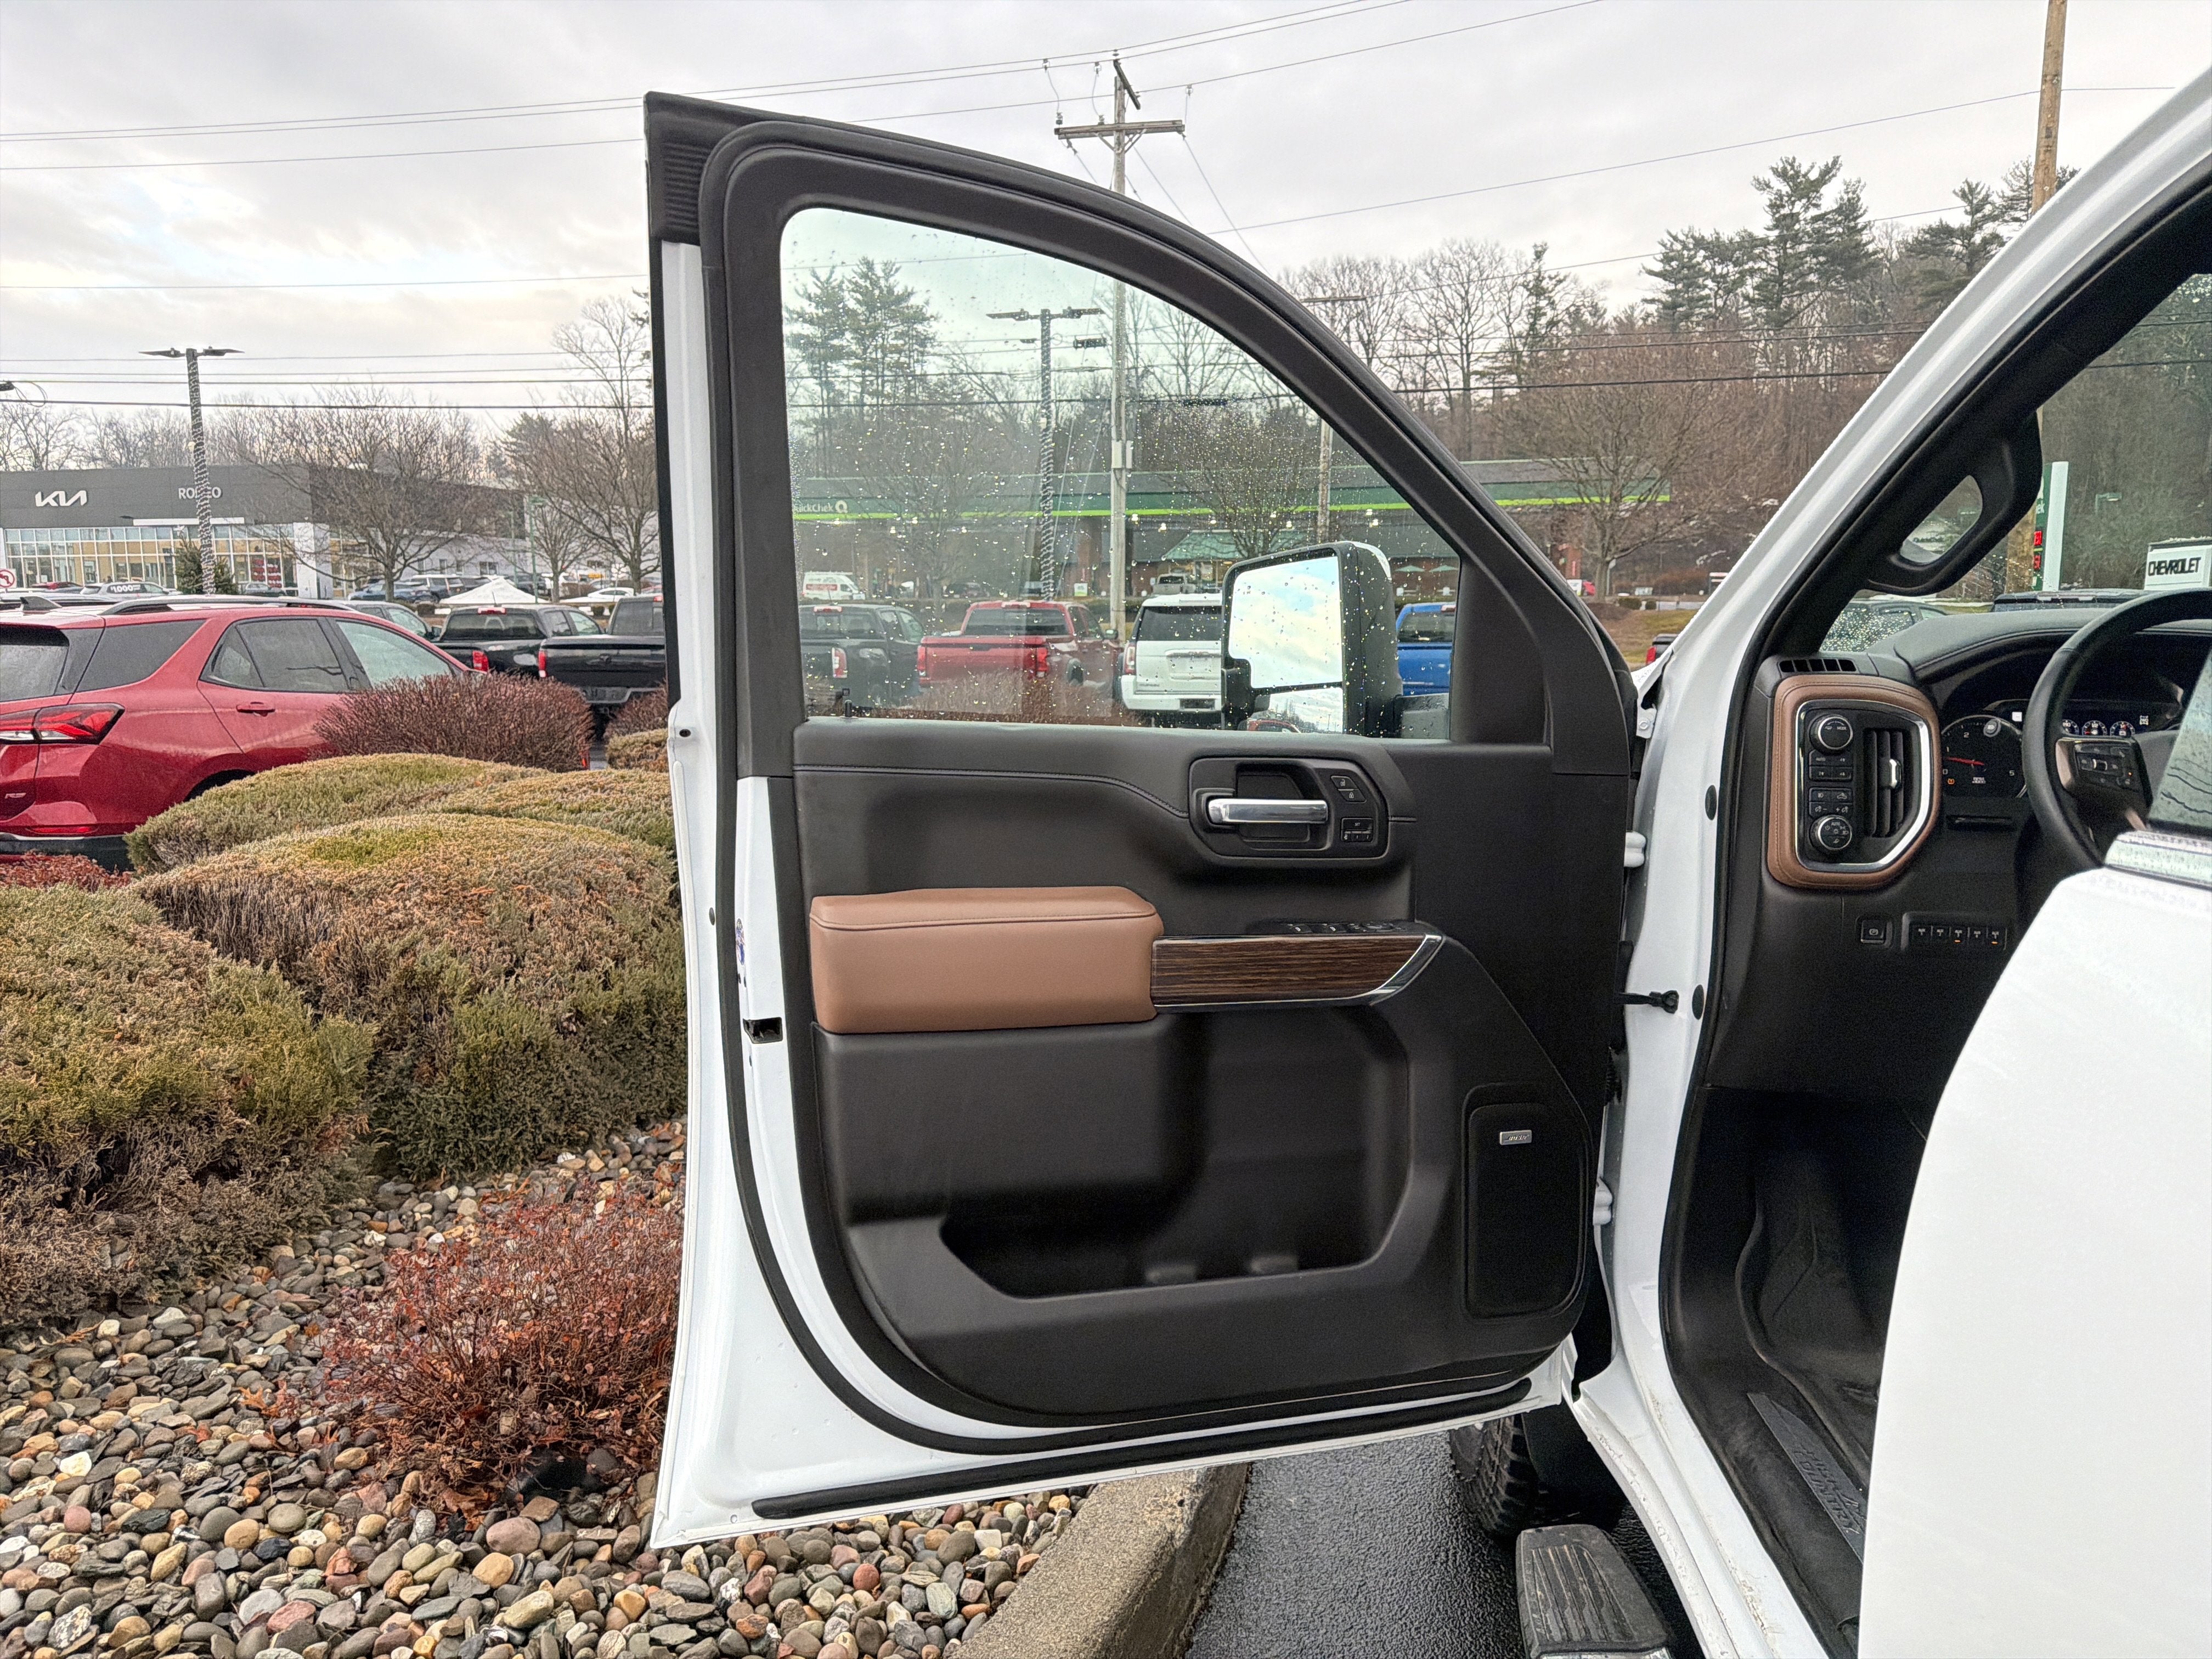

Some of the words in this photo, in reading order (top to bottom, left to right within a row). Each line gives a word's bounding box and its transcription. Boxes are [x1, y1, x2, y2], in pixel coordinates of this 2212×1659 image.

[35, 490, 88, 507] KIA
[178, 487, 222, 499] ROO
[2148, 556, 2202, 577] CHEVROLET
